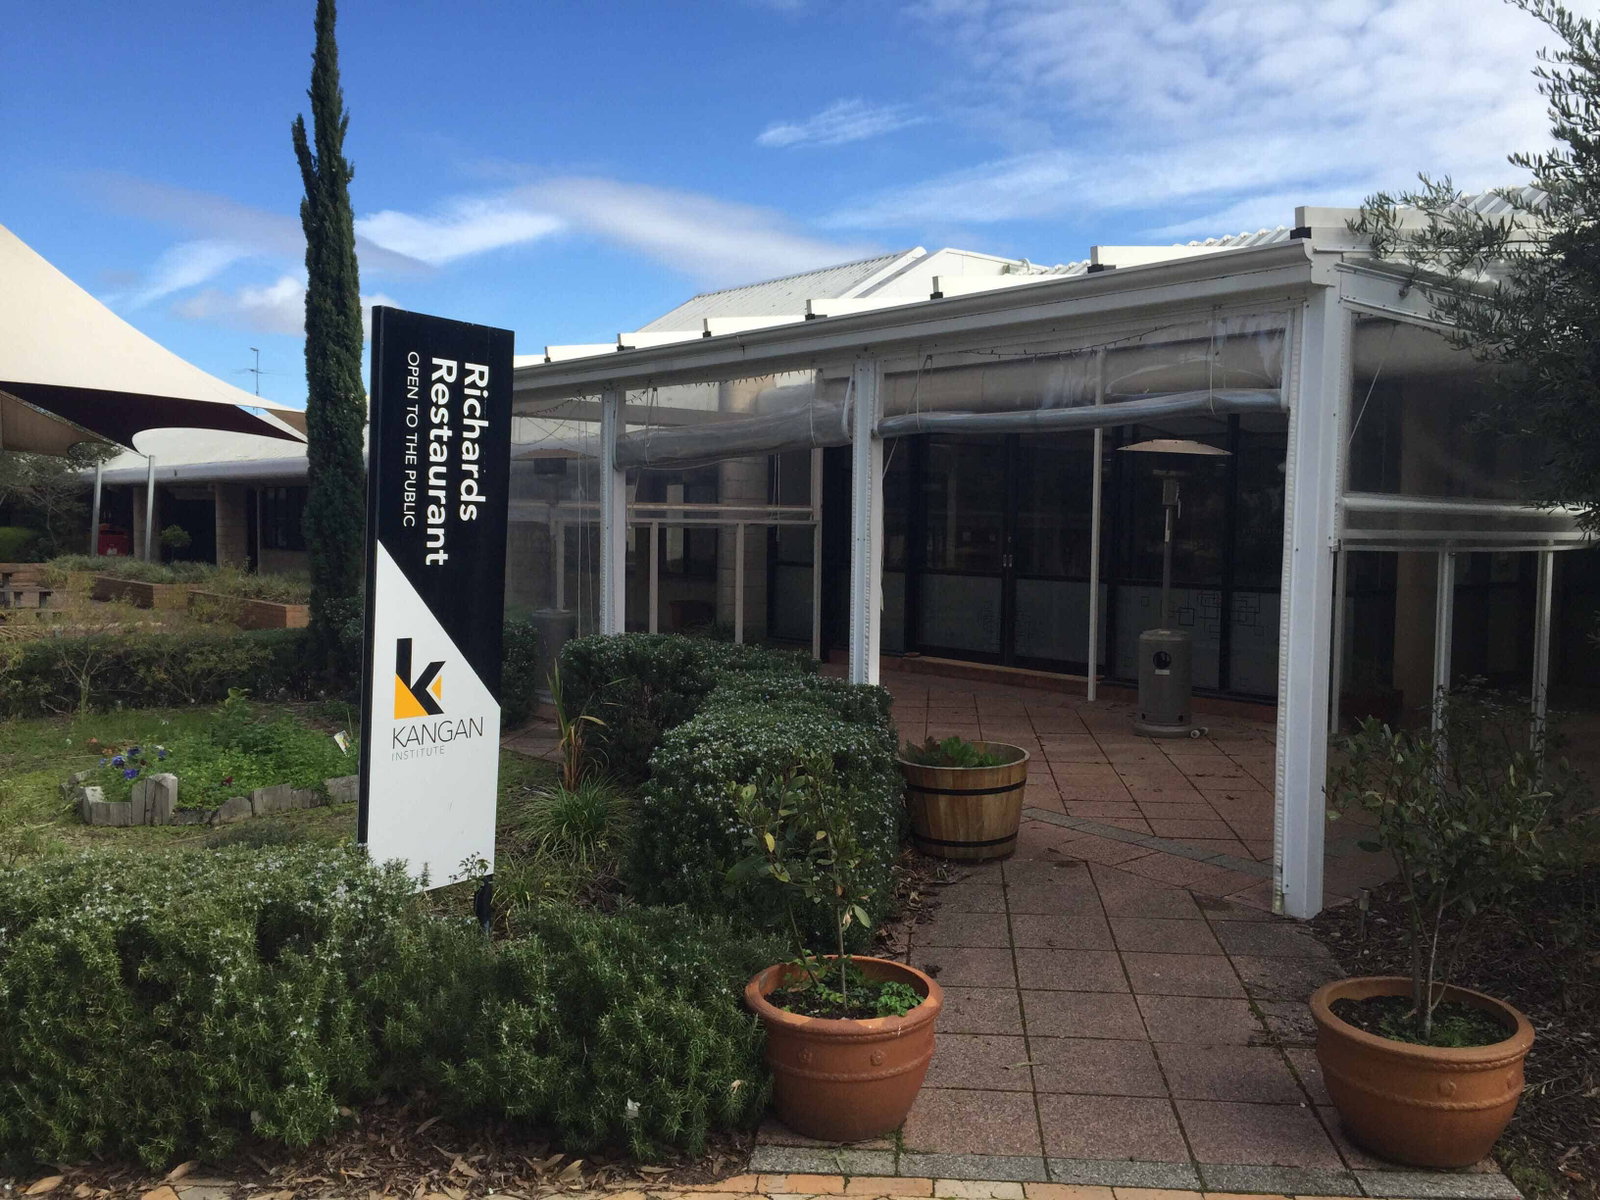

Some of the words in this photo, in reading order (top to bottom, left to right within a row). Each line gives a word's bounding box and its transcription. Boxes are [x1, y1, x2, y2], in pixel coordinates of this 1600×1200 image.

[406, 351, 420, 399] OPEN
[406, 404, 419, 428] TO
[405, 432, 418, 465] THE
[425, 357, 458, 566] Restaurant
[460, 362, 489, 522] Richards
[403, 470, 417, 527] PUBLIC
[392, 716, 484, 749] KANGAN
[391, 745, 446, 761] INSTITUTE
